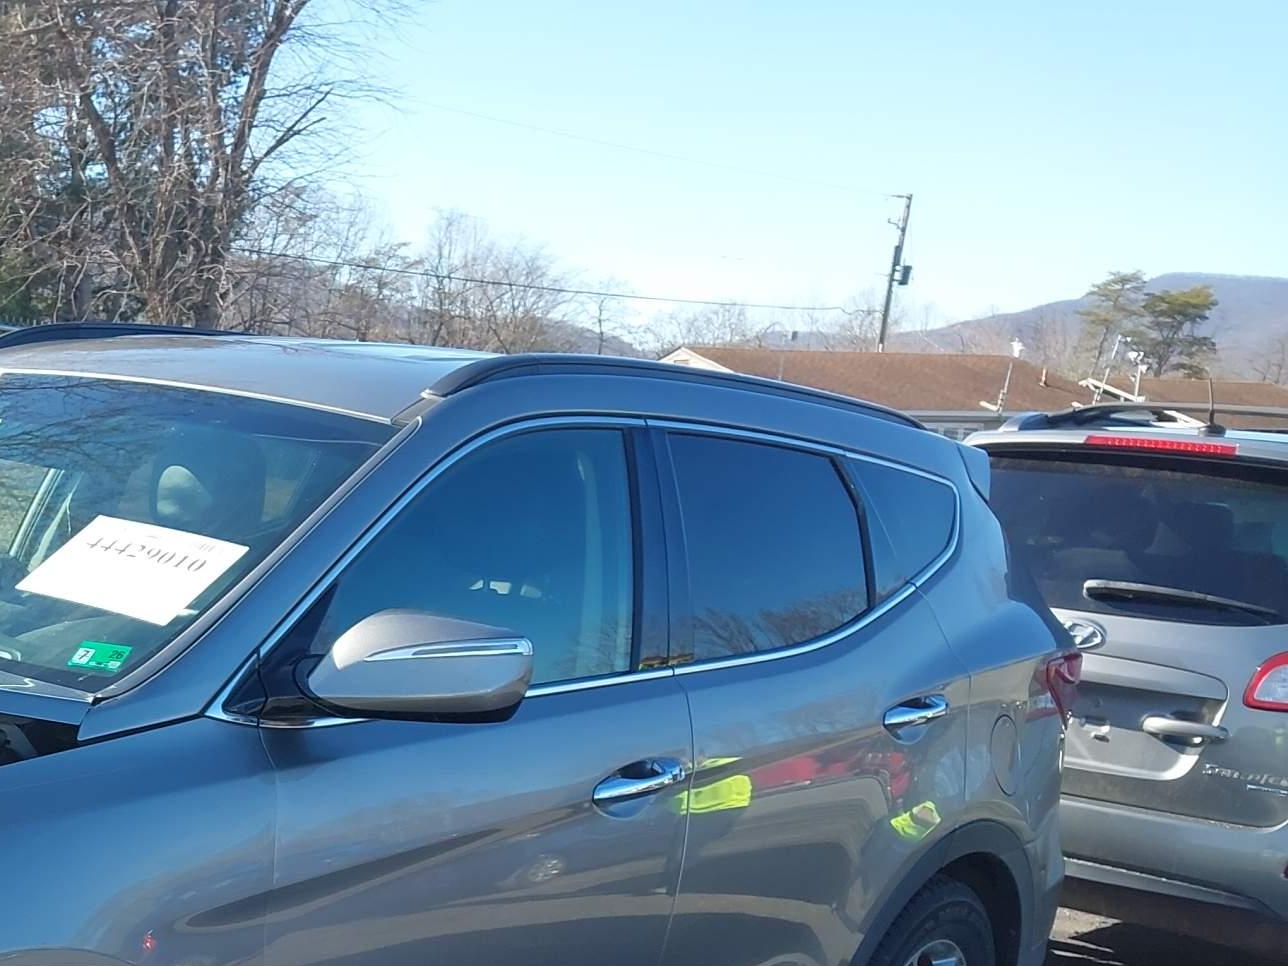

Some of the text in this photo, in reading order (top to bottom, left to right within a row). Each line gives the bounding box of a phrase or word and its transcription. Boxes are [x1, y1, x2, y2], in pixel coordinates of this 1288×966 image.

[86, 537, 207, 572] 44429010
[78, 645, 126, 660] 7 26
